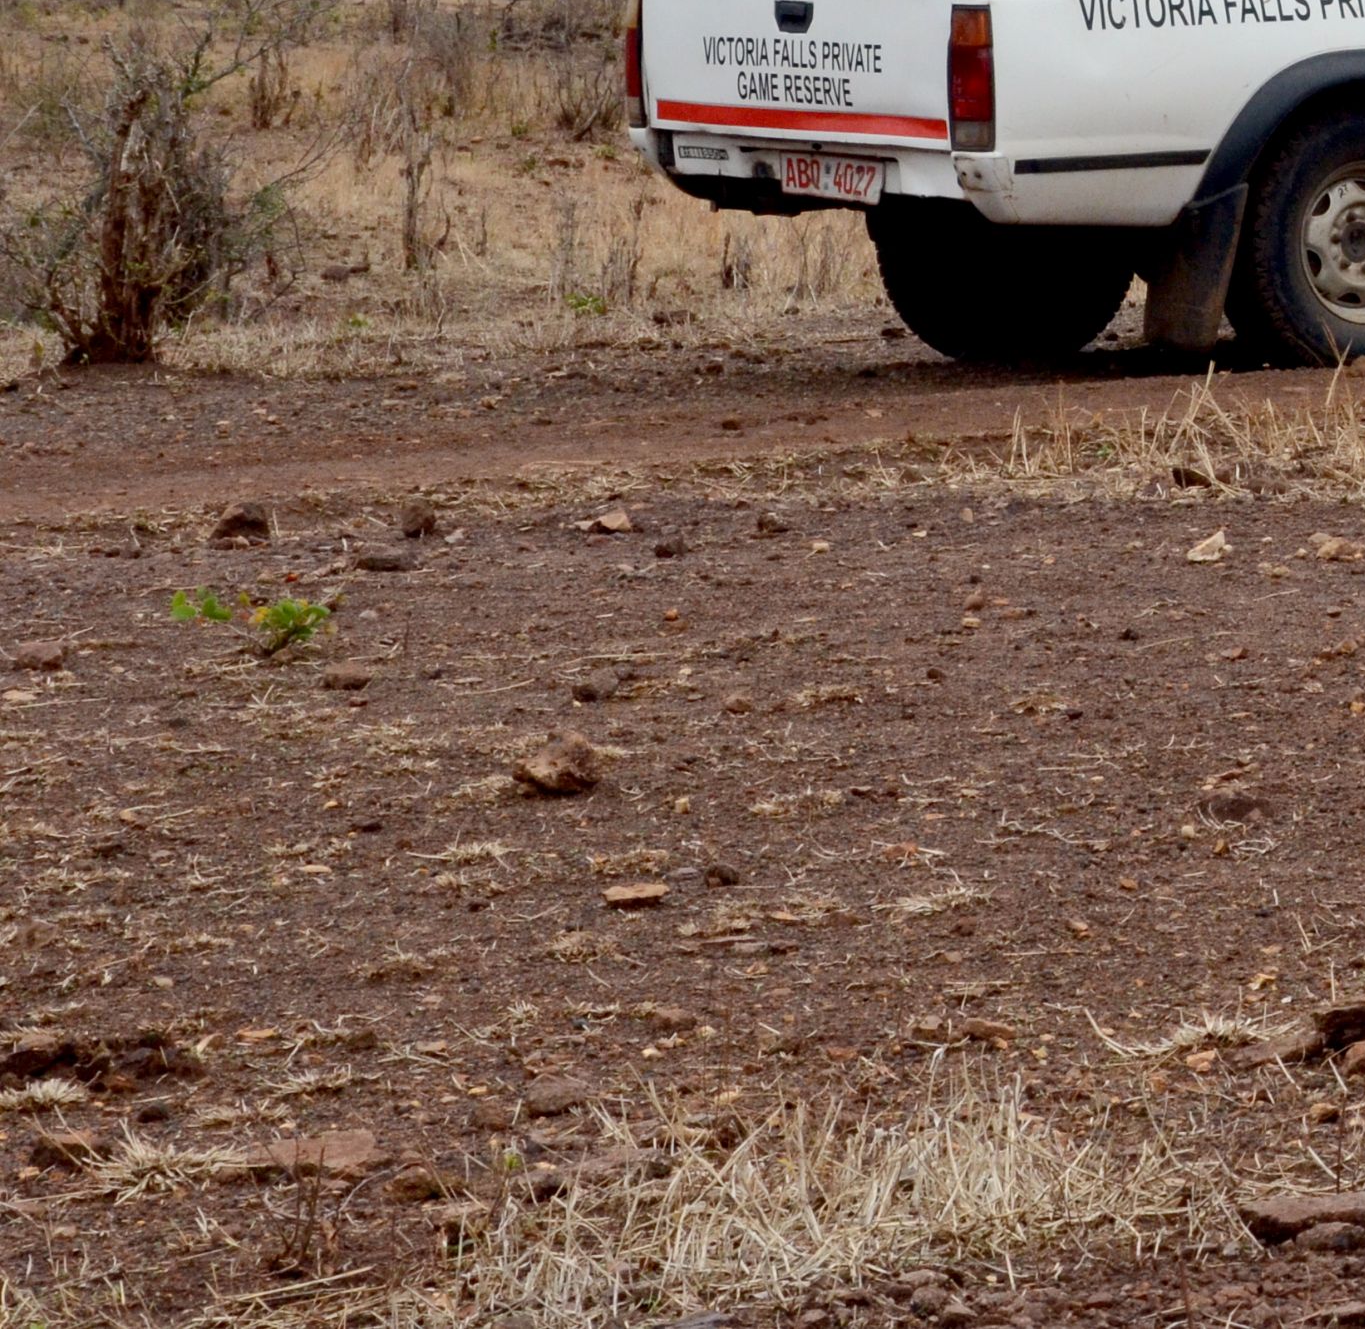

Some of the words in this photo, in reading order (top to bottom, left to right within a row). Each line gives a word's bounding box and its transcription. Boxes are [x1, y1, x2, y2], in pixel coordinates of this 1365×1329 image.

[703, 36, 769, 66] VICTORIA
[773, 39, 817, 69] FALLS
[822, 42, 882, 73] PRIVATE
[737, 71, 780, 102] GAME
[784, 75, 853, 107] RESERVE
[833, 161, 877, 197] 4027
